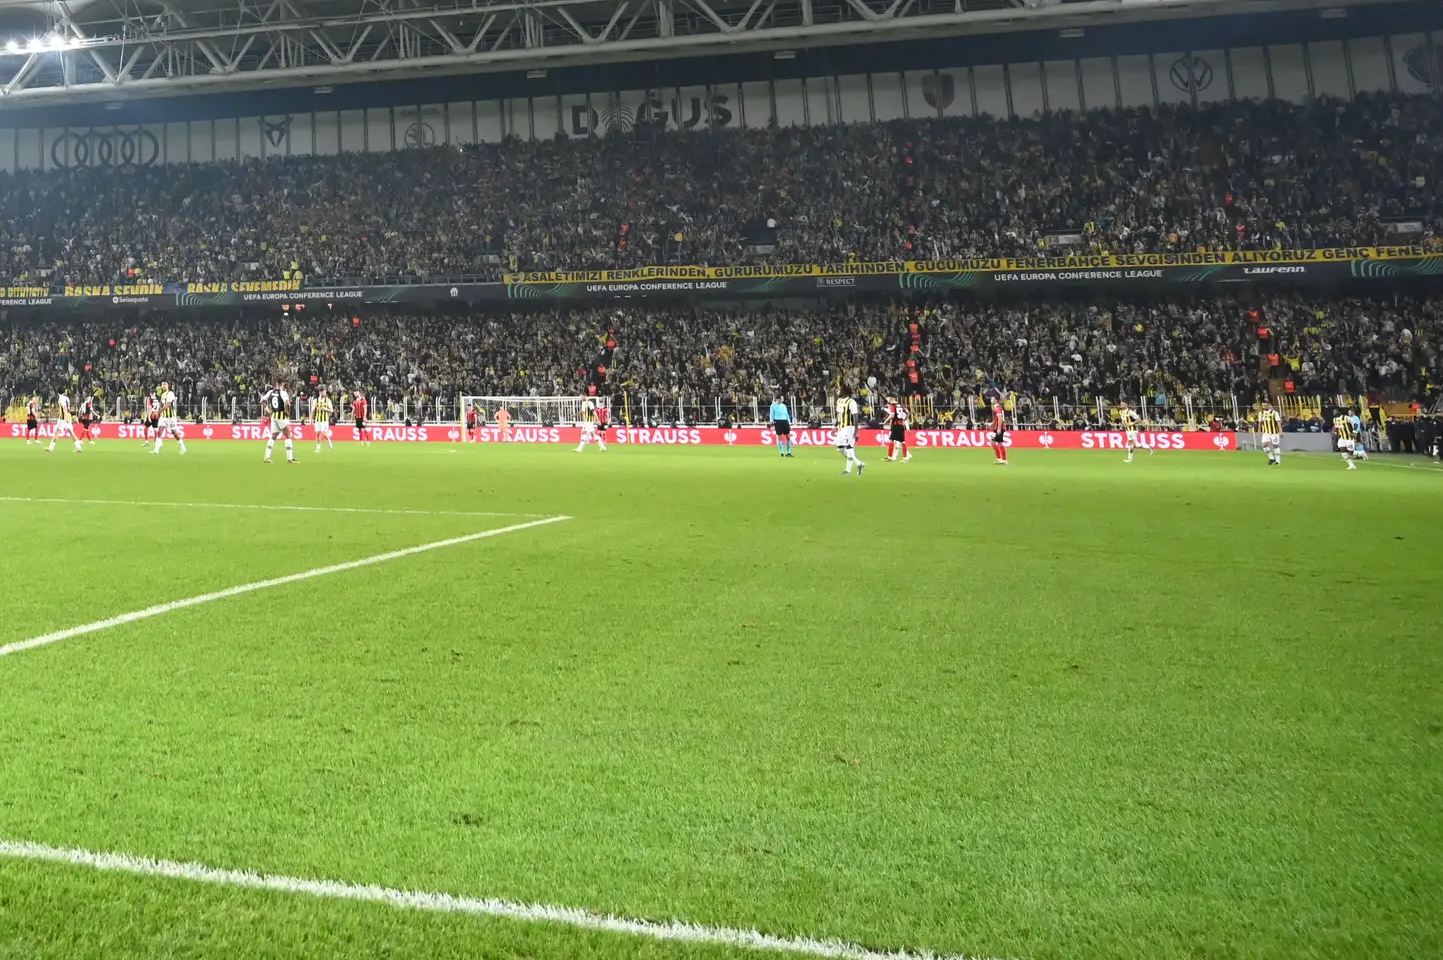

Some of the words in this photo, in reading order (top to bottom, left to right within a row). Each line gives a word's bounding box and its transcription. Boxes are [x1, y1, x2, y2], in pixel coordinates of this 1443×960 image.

[1231, 250, 1310, 263] ALIYORUZ
[1321, 247, 1366, 262] GENÇ
[825, 276, 856, 286] RESPECT
[994, 274, 1019, 282] UEFA
[1020, 273, 1057, 281] EUROPA
[1058, 271, 1122, 280] CONFERENCE
[1124, 269, 1163, 279] LEAGUE
[586, 284, 608, 292] UEFA
[608, 283, 639, 291] EUROPA
[640, 282, 693, 290] CONFERENCE
[695, 281, 727, 289] LEAGUE
[28, 297, 53, 305] LEAGUE
[118, 296, 149, 304] Swissquote
[243, 293, 261, 301] UEFA
[262, 292, 288, 300] EUROPA
[289, 291, 334, 299] CONFERENCE
[336, 290, 363, 298] LEAGUE
[616, 428, 701, 444] STRAUSS
